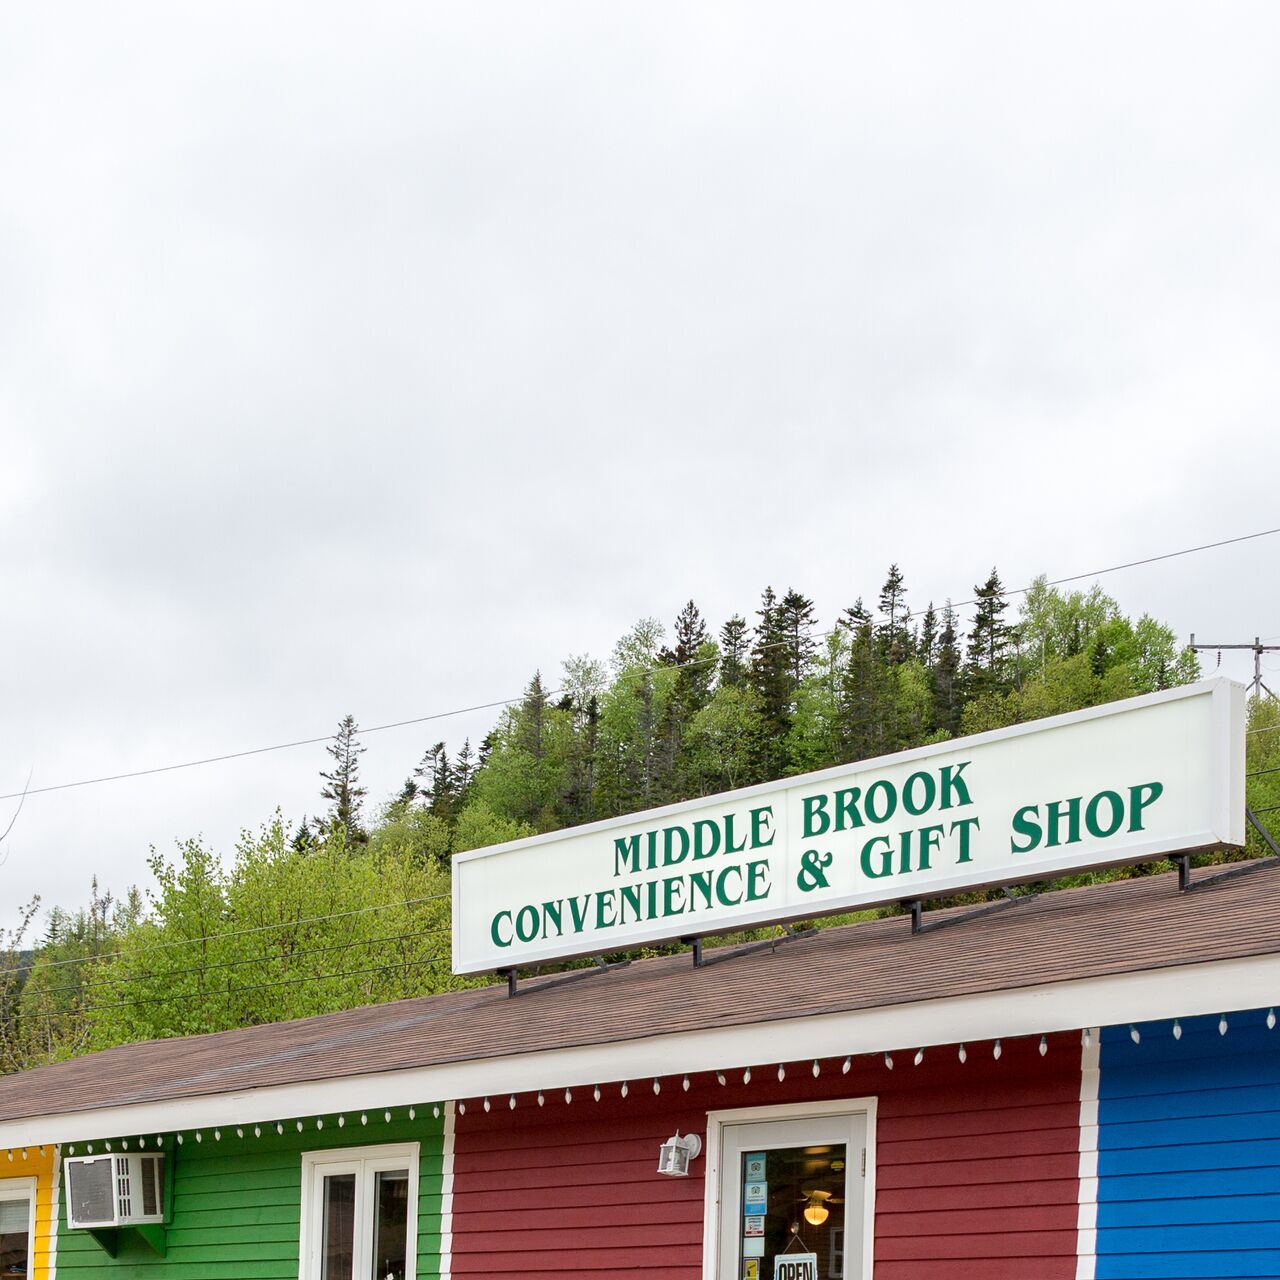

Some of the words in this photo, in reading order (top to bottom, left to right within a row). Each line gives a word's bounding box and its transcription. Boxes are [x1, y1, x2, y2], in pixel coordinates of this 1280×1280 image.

[490, 859, 771, 948] CONVENIENCE
[797, 849, 833, 892] &
[860, 817, 980, 880] GIFT
[1010, 782, 1164, 854] SHOP
[613, 806, 776, 876] MIDDLE
[801, 761, 972, 839] BROOK
